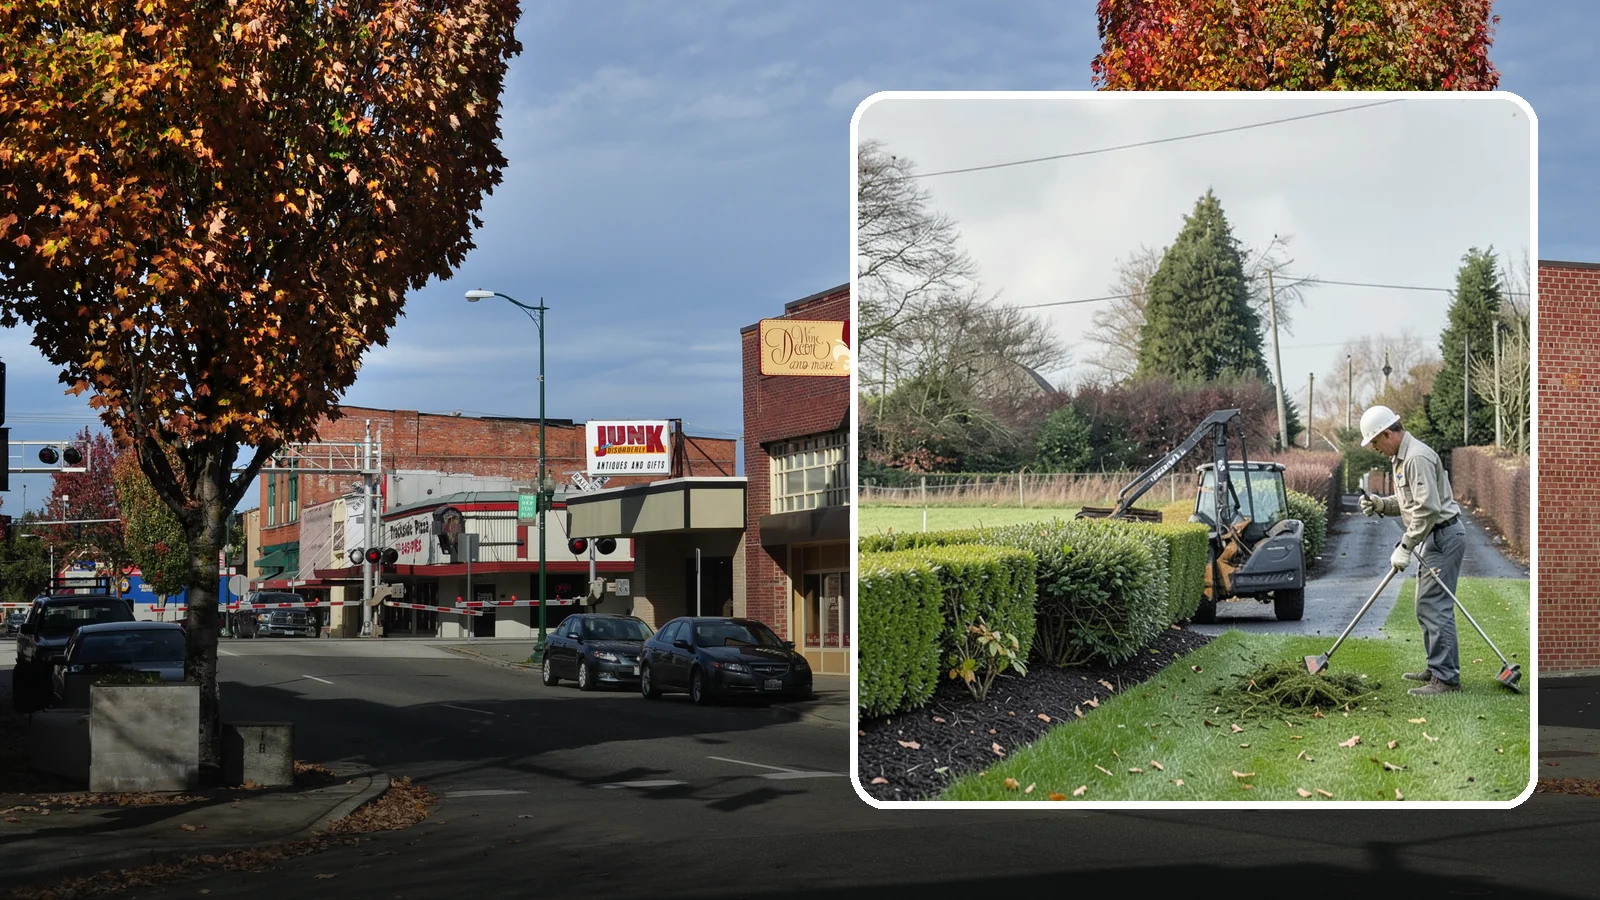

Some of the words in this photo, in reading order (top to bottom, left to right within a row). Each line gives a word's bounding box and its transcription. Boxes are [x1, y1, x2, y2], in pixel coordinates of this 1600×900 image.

[595, 425, 665, 457] JUNK
[607, 446, 646, 454] DISORDERLY
[597, 461, 628, 470] ANTIQUES
[630, 461, 644, 470] AND
[646, 460, 665, 470] GIFTS
